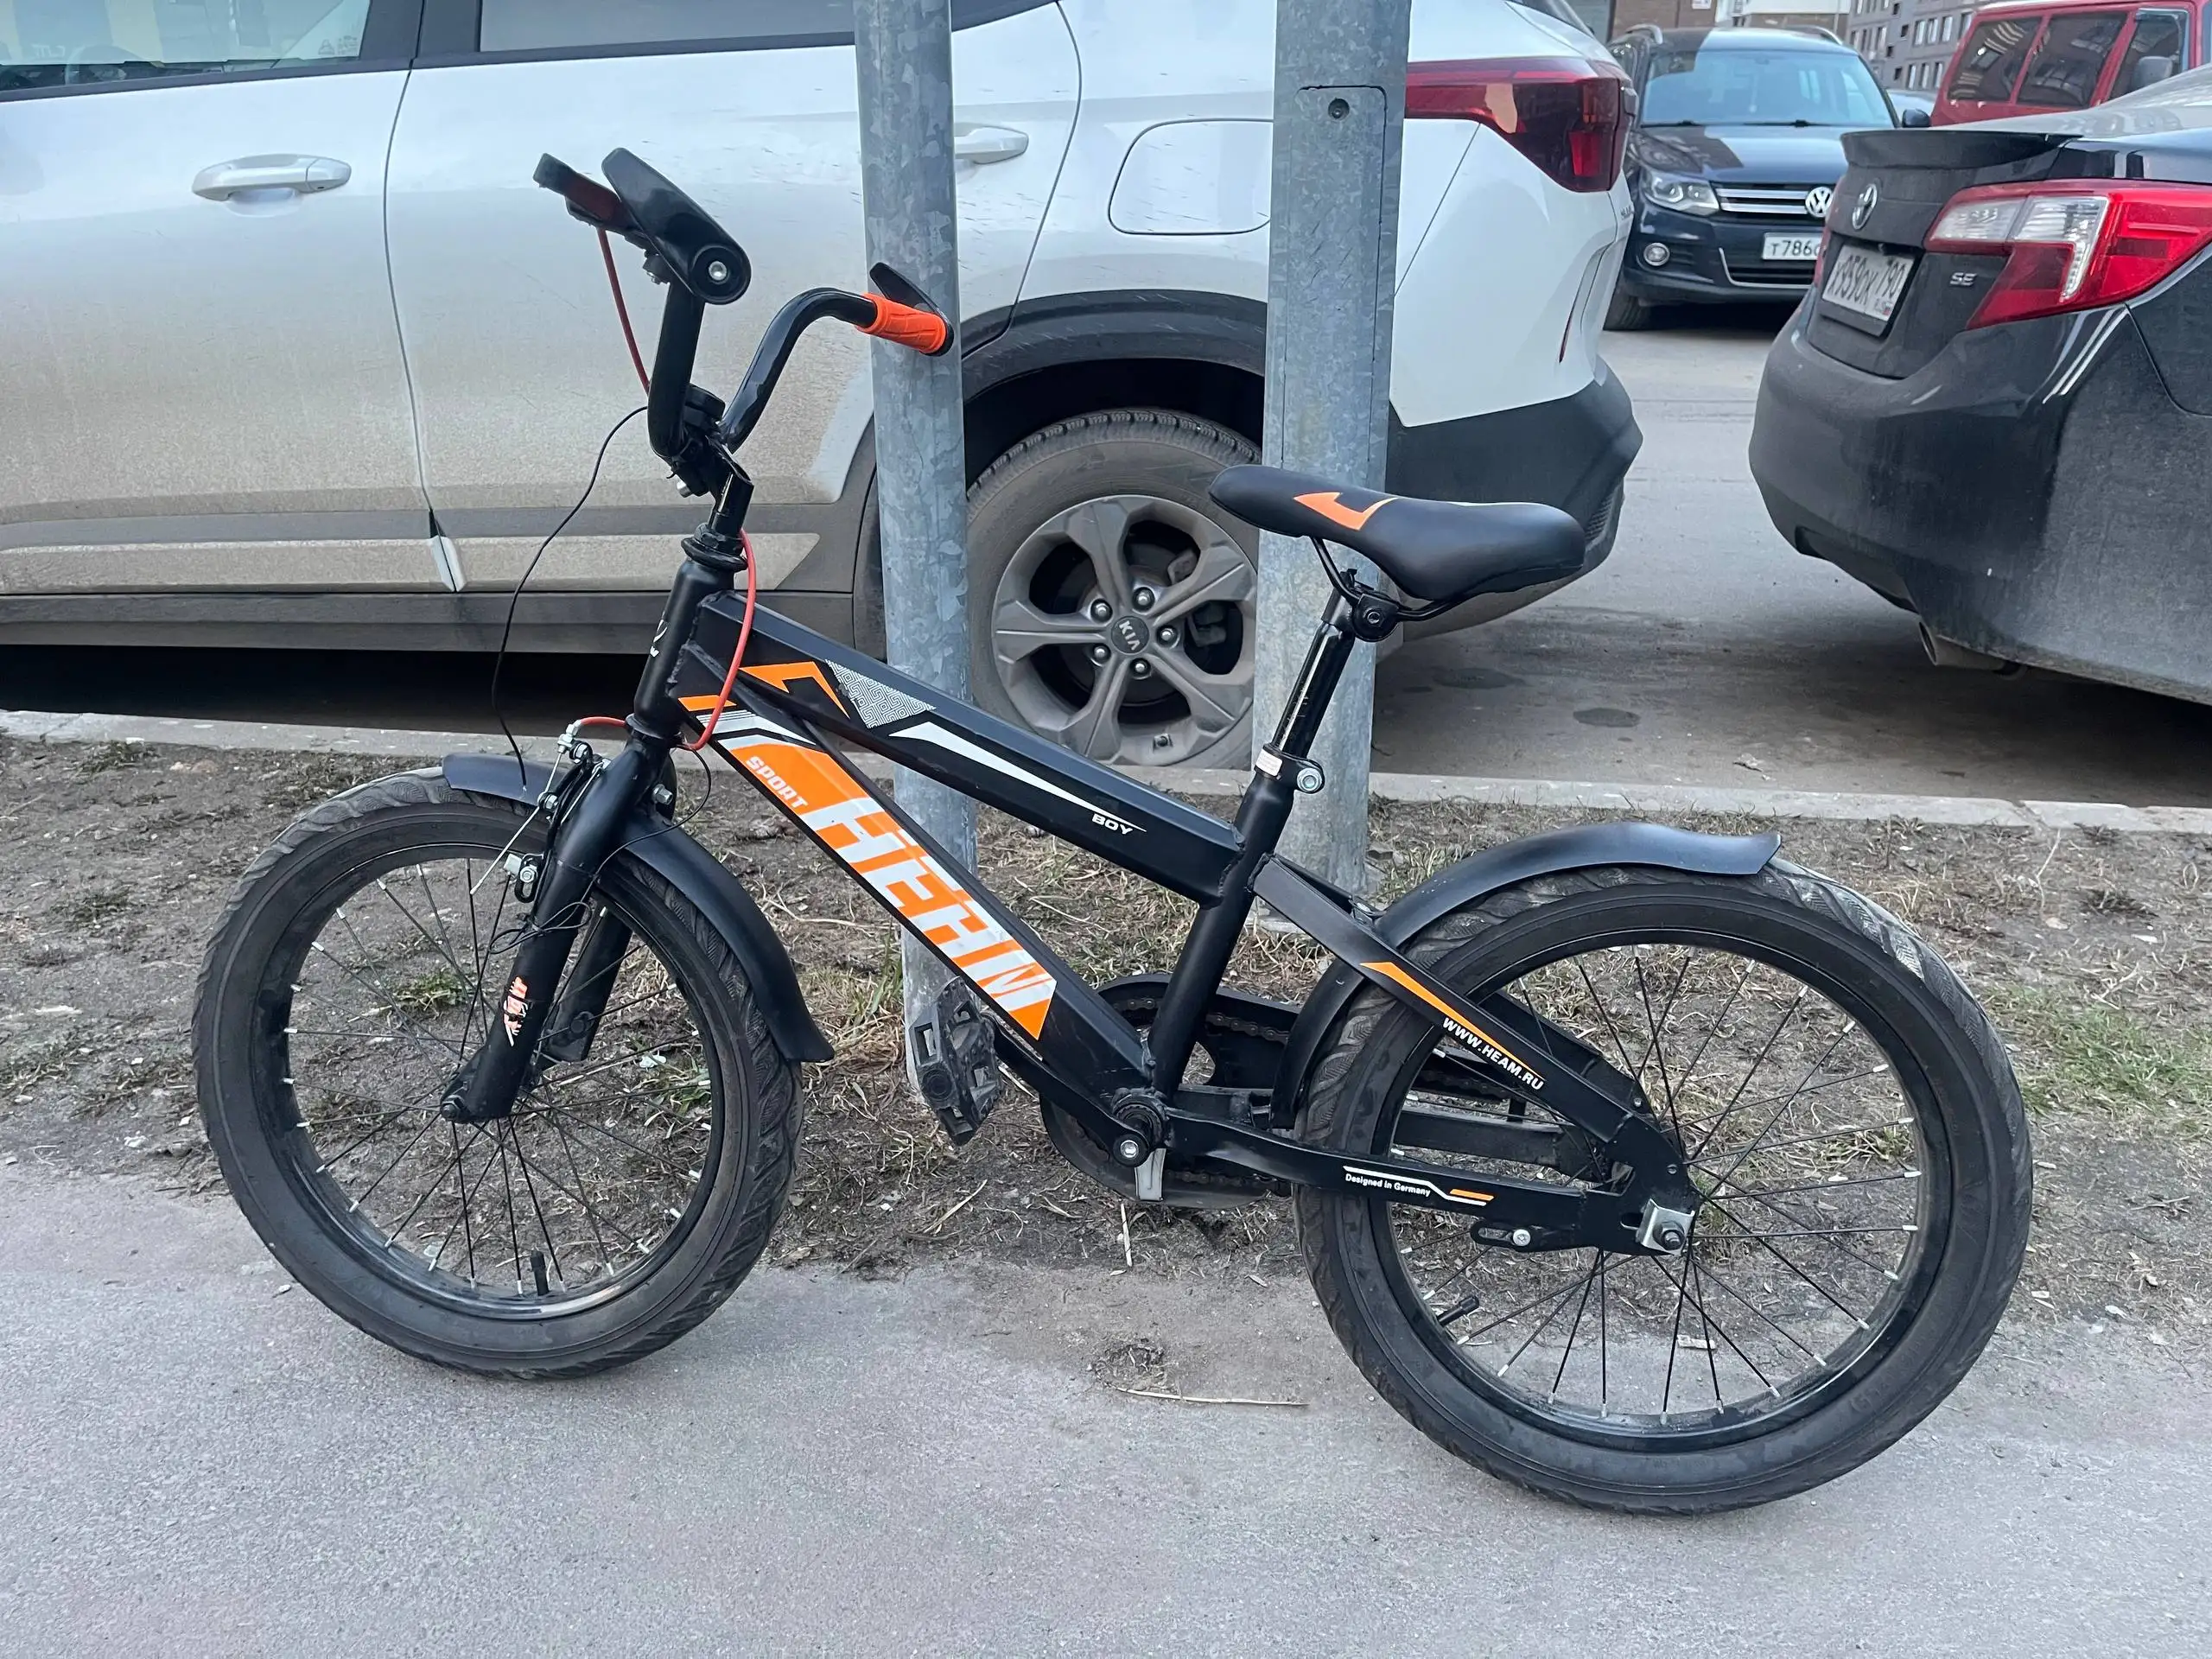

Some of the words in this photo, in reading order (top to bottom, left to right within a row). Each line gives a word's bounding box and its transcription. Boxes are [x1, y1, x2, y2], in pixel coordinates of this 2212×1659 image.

[1950, 272, 1978, 287] SE
[1119, 620, 1141, 651] KIA
[746, 756, 809, 808] SPORT
[1092, 813, 1134, 835] BOY
[1442, 1017, 1544, 1090] WWW.HEAM.RU
[1345, 1173, 1382, 1188] Designed
[1384, 1180, 1392, 1189] in
[1394, 1182, 1431, 1198] Germany
